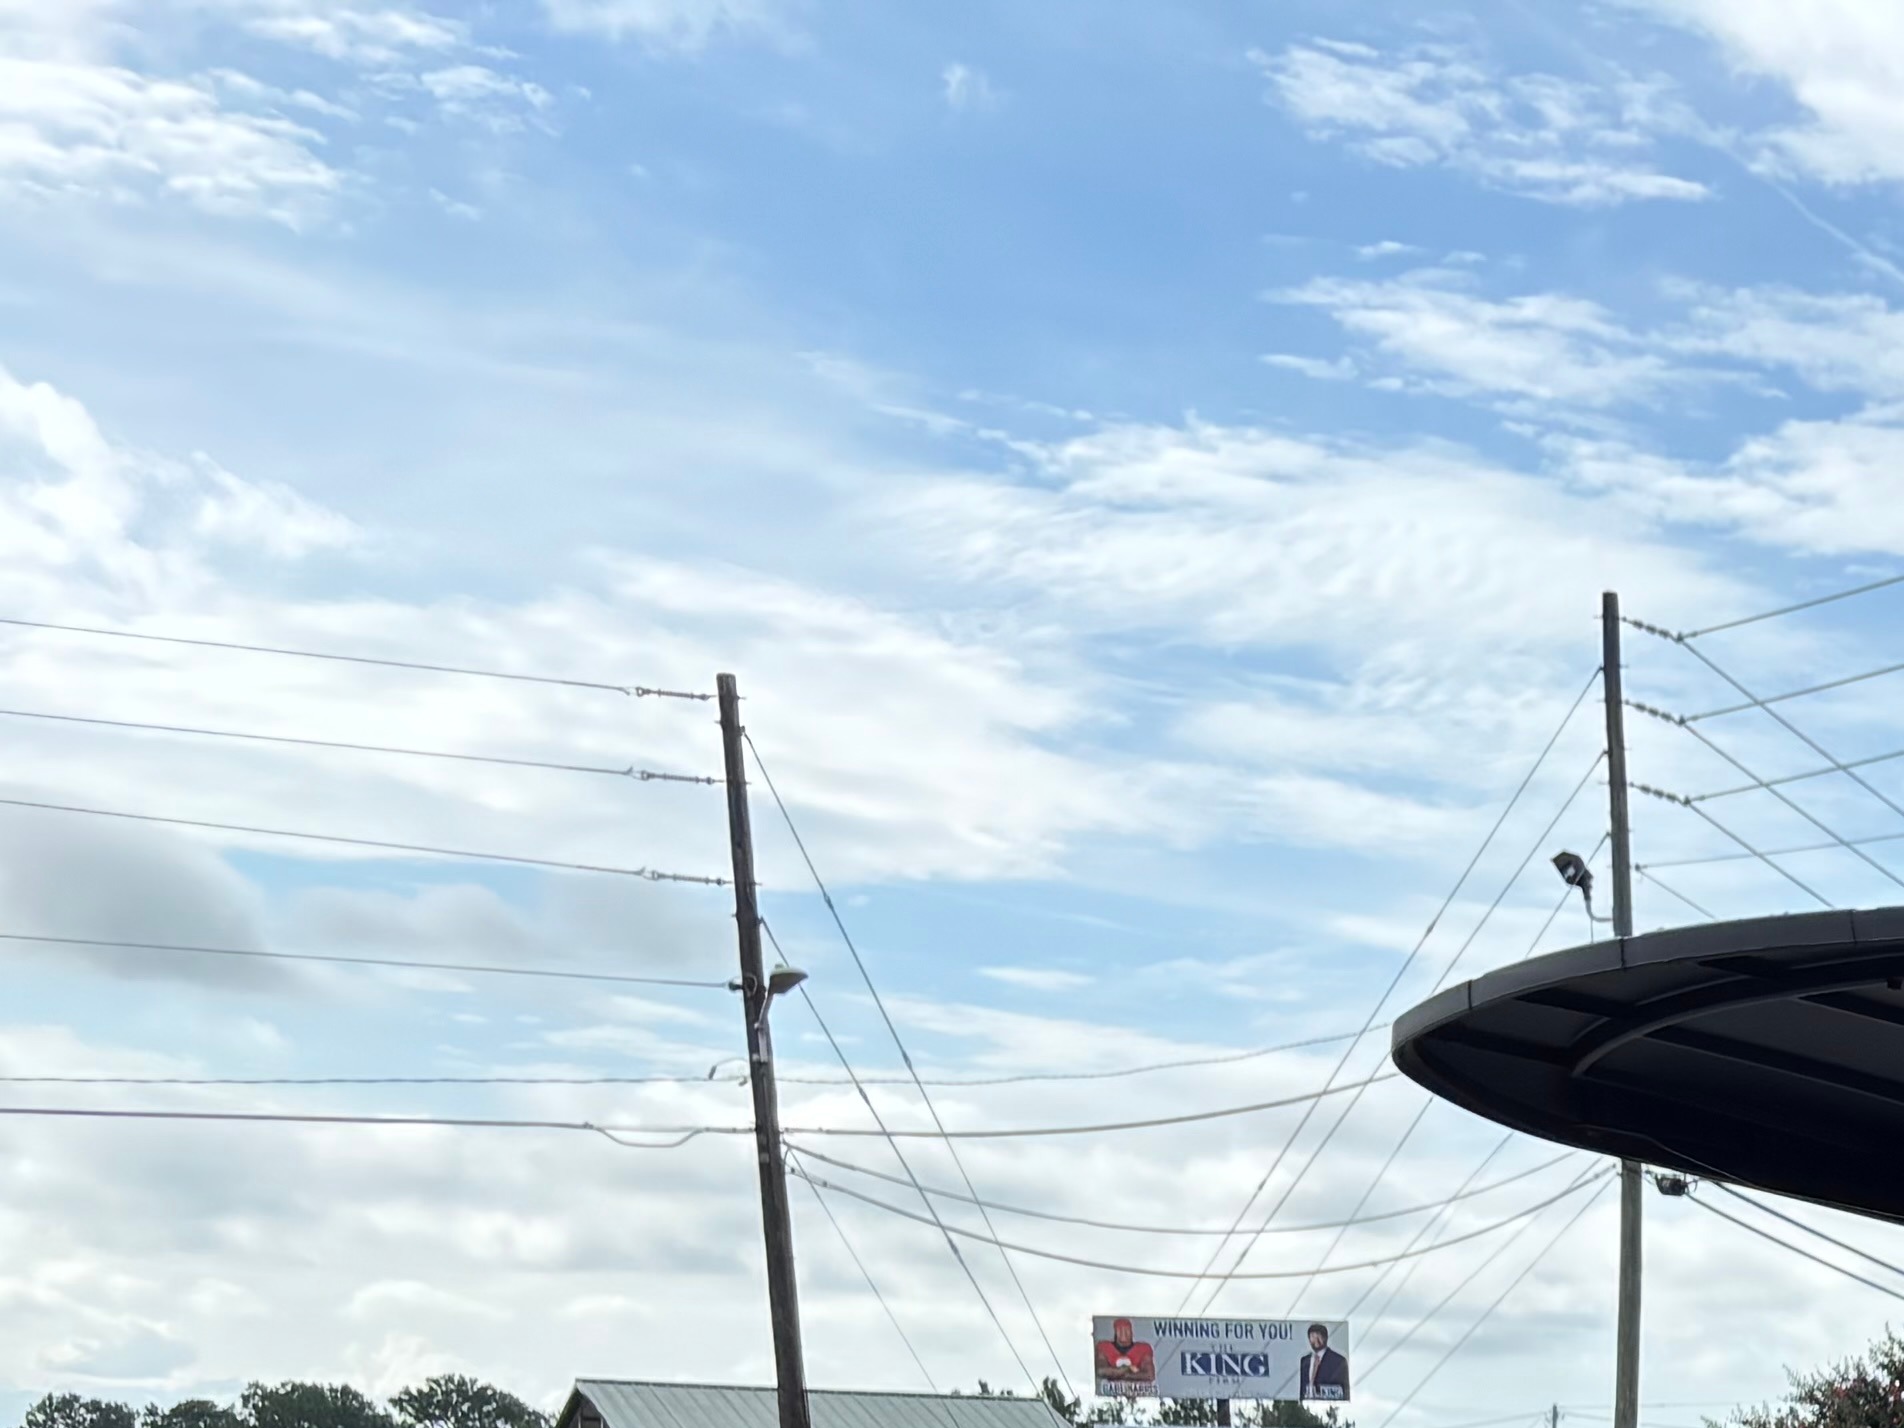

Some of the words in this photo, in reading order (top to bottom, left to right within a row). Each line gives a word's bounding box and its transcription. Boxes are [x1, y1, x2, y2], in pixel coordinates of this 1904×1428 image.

[1153, 1320, 1220, 1339] WINNING
[1225, 1322, 1254, 1340] FOR
[1259, 1323, 1293, 1341] YOU!
[1185, 1352, 1265, 1376] KING
